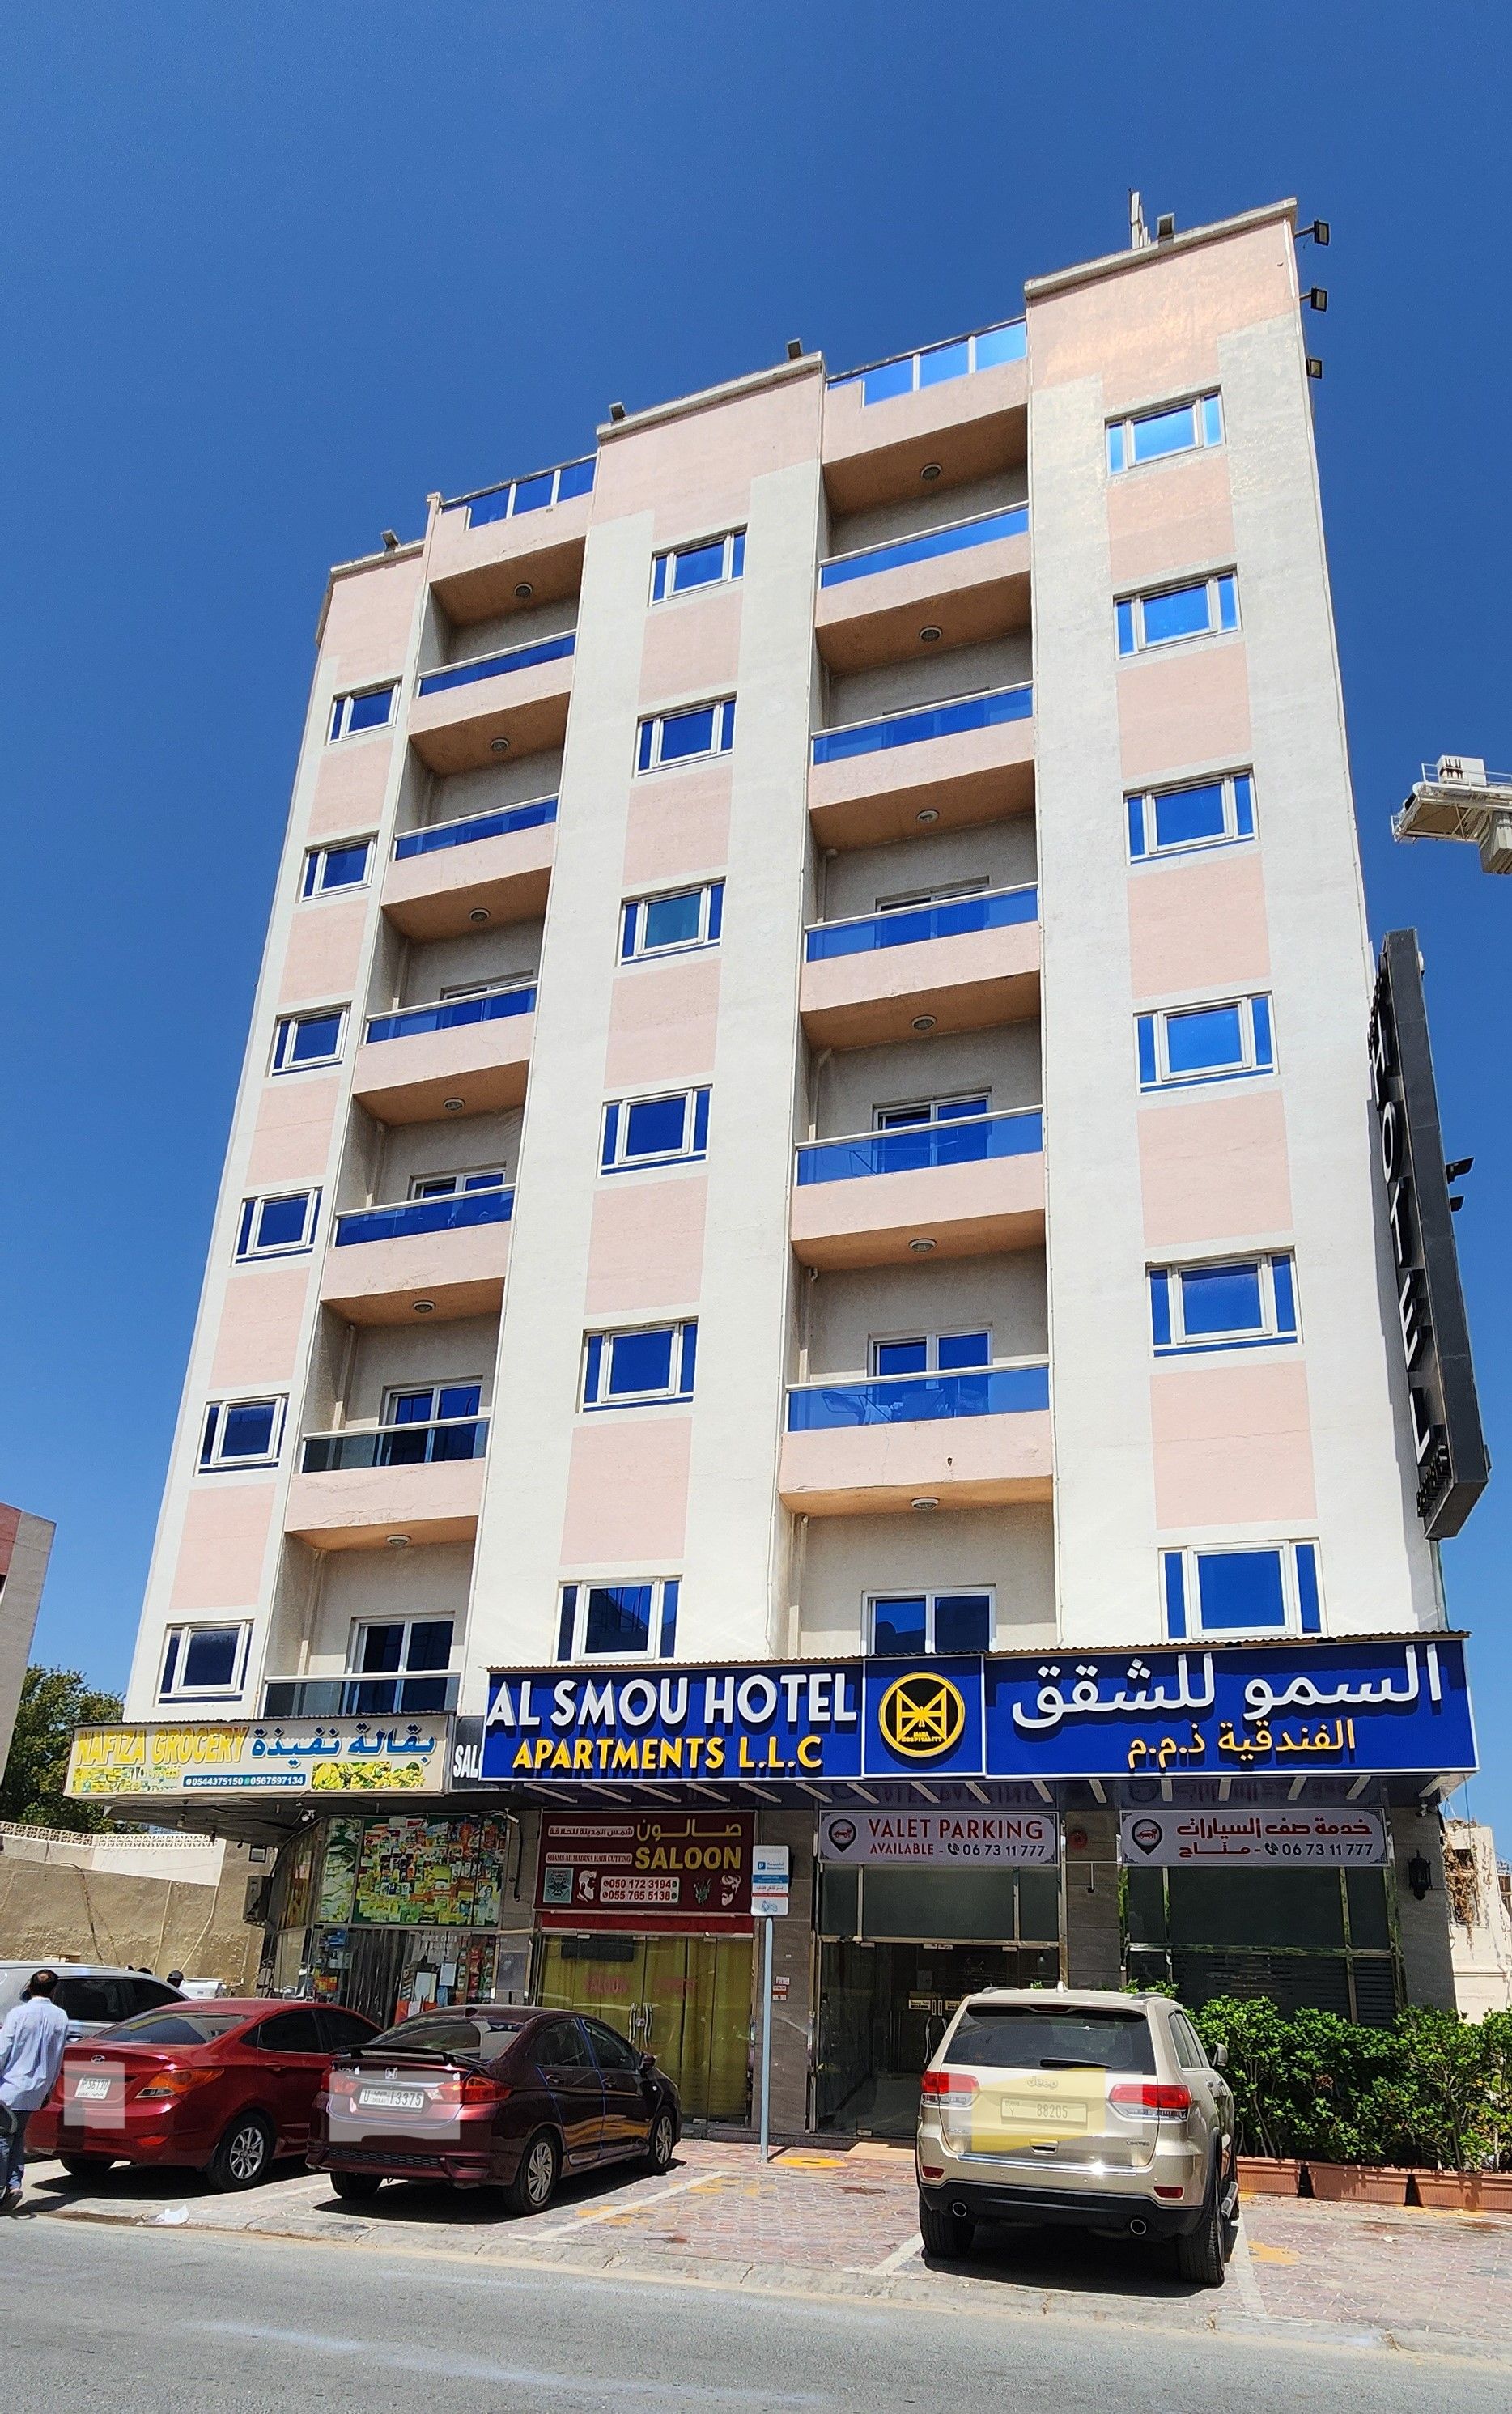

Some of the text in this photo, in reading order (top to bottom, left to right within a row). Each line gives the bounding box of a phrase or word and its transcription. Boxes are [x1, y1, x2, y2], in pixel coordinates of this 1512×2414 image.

[1013, 1643, 1442, 1728] السمو للشقق
[486, 1673, 857, 1726] AL SMOU HOTEL
[76, 1726, 249, 1766] NAFIZA GROCERY
[348, 1723, 435, 1765] بقالة
[512, 1736, 822, 1770] APARTMENTS L.L.C
[1128, 1718, 1355, 1769] الفندقية ذ.م.م
[637, 1819, 742, 1842] صالون
[869, 1819, 1043, 1840] VALET PARKING
[1177, 1817, 1372, 1838] خدمة صف السيارات
[635, 1847, 741, 1870] SALOON
[870, 1842, 933, 1855] AVAILABLE
[963, 1844, 981, 1855] 06
[985, 1845, 1000, 1855] 73
[1006, 1845, 1016, 1855] 11
[1021, 1845, 1046, 1856] 777
[1179, 1841, 1251, 1857] متاح
[1282, 1843, 1302, 1855] 06
[1306, 1843, 1325, 1855] 73
[1330, 1844, 1342, 1855] 11
[1347, 1843, 1374, 1855] 777
[609, 1879, 671, 1889] 050 172 3194
[609, 1890, 670, 1901] 055 765 5138
[1027, 2076, 1058, 2089] Jeep
[364, 2090, 370, 2102] U
[390, 2092, 422, 2106] 13375
[1009, 2107, 1015, 2116] Y
[1037, 2103, 1068, 2119] 88205
